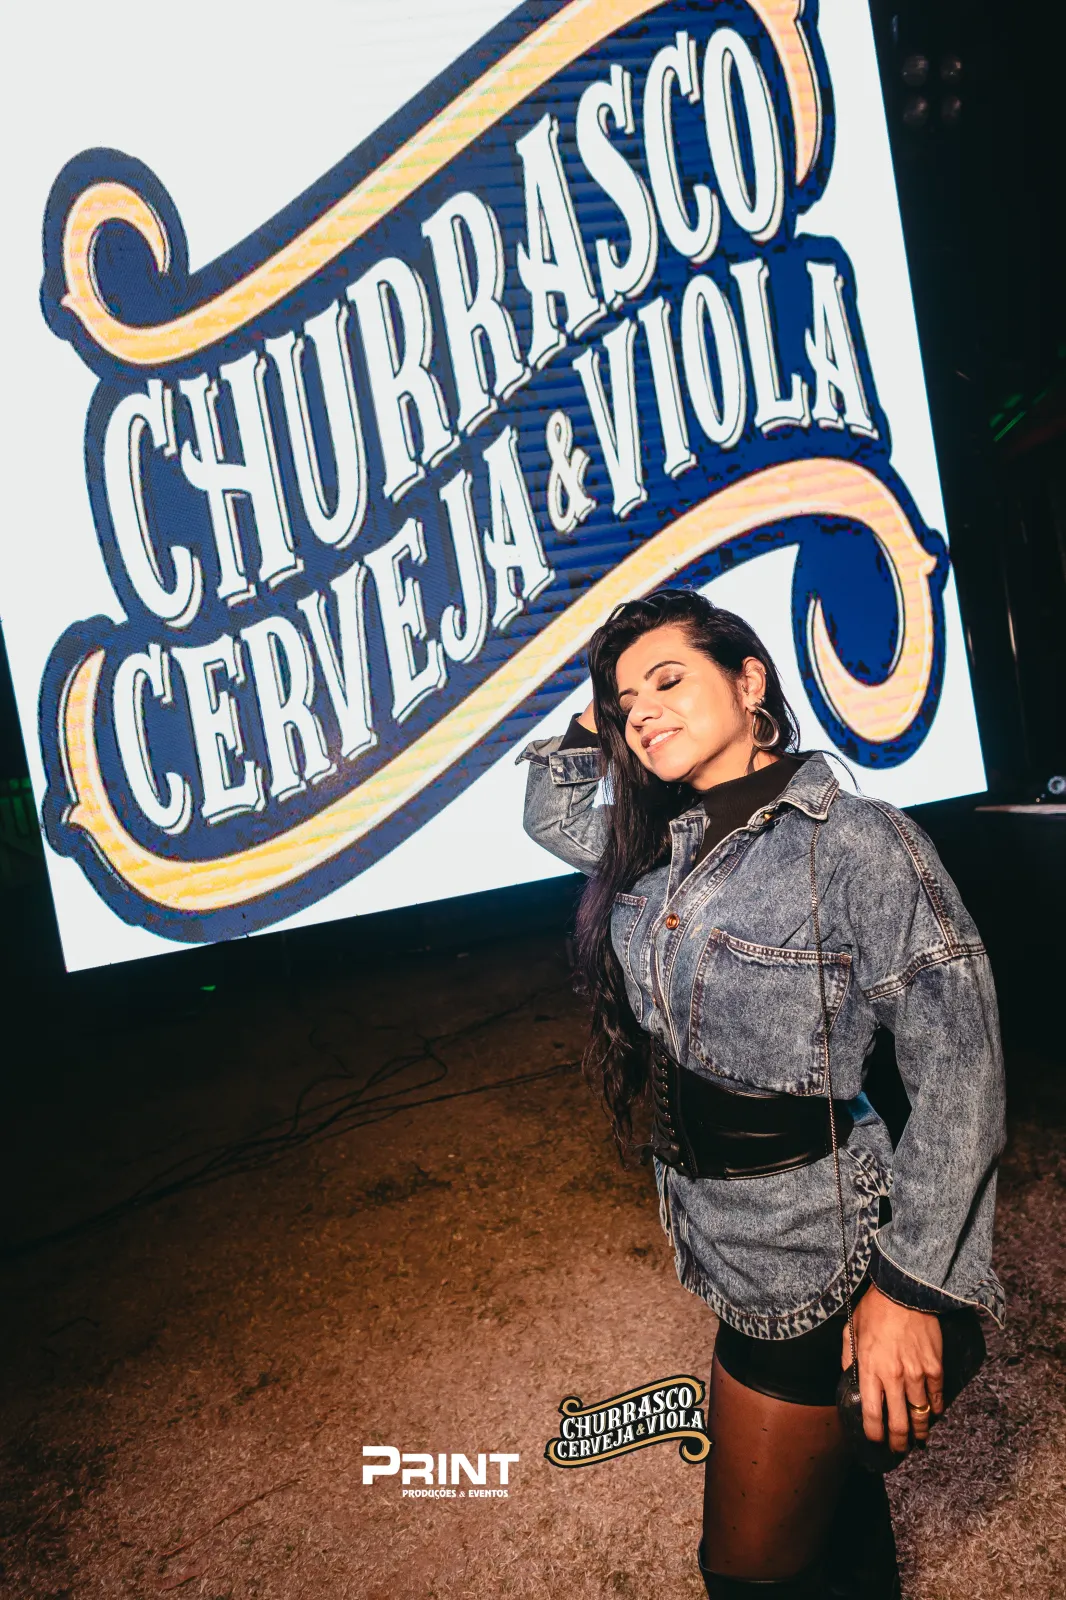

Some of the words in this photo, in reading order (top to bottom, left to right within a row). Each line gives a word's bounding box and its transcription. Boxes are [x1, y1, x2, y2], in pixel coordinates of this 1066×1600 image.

[102, 26, 785, 630] CHURRASCO
[111, 426, 556, 835] CERVEJA
[546, 409, 597, 536] &
[573, 257, 881, 518] VIOLA
